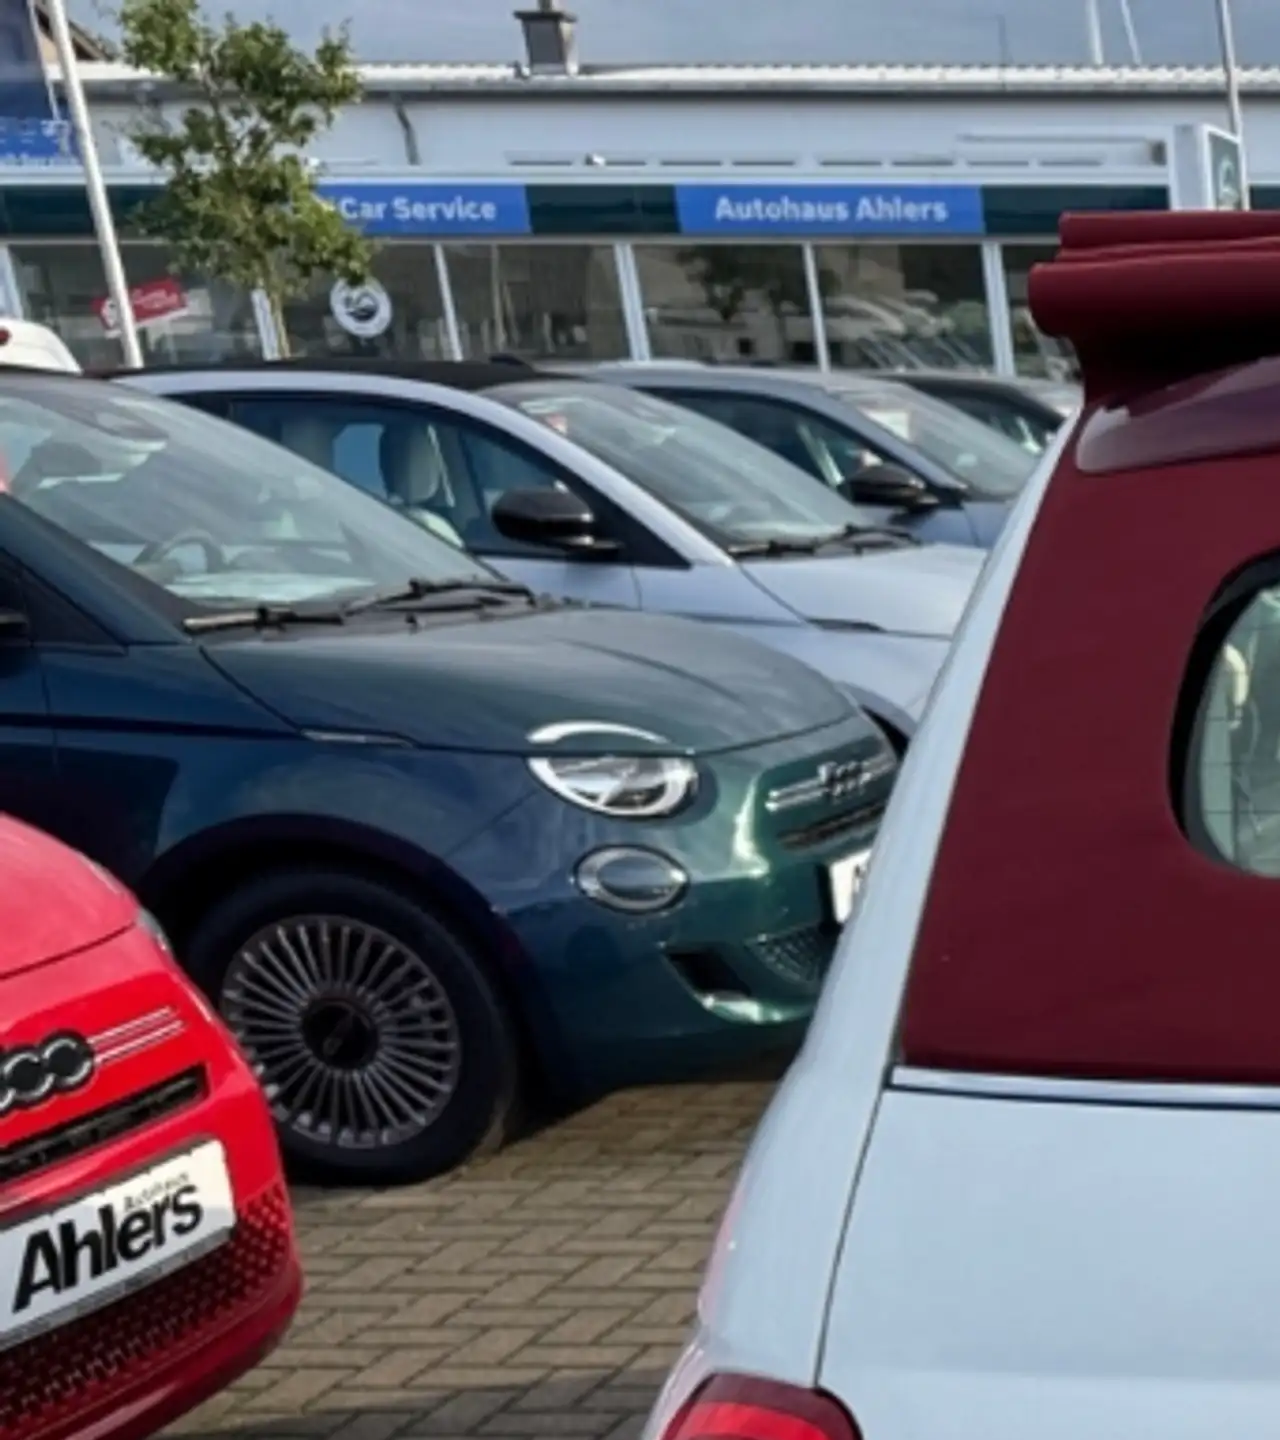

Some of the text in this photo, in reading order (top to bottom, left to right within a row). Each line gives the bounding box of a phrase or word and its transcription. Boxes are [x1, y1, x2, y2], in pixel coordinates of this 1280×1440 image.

[340, 196, 497, 220] Car Service
[715, 196, 948, 222] Autohaus Ahlers
[0, 1038, 92, 1110] 00
[12, 1184, 204, 1313] Ahlers
